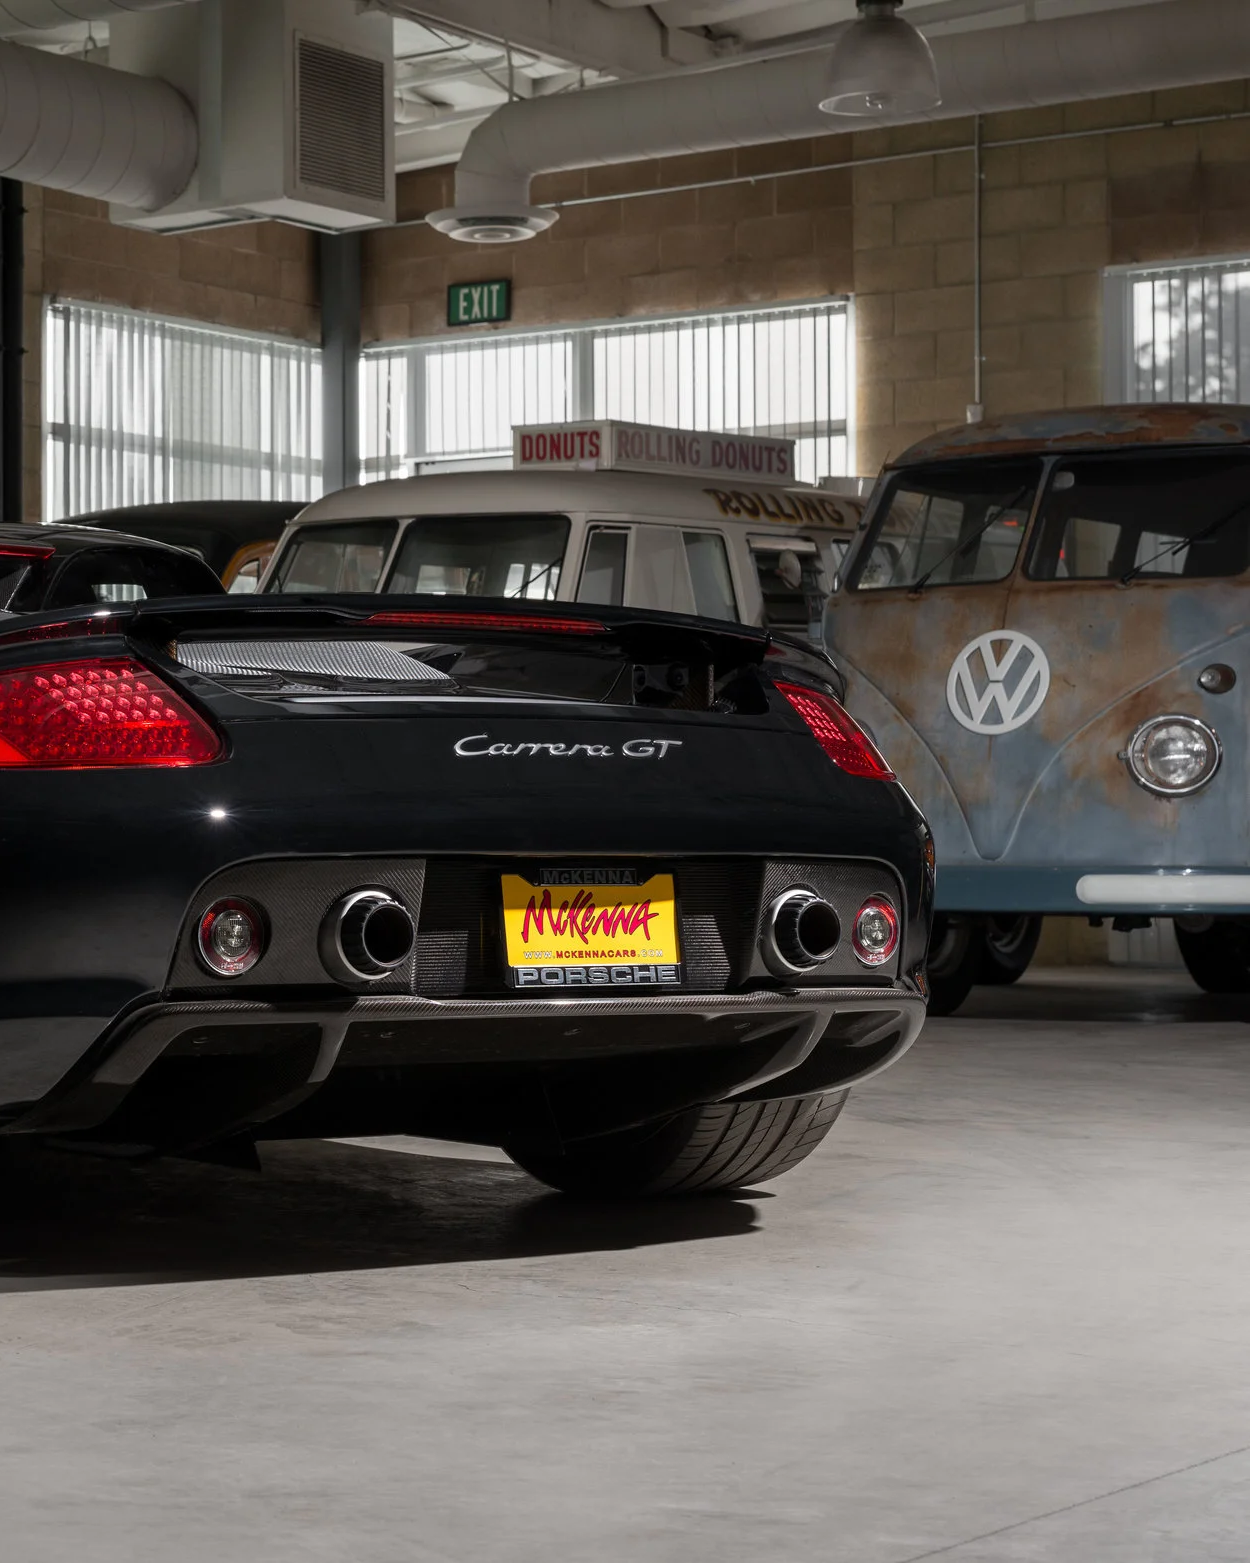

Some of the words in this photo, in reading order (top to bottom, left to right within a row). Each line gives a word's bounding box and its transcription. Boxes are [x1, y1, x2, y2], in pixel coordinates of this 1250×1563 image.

[458, 284, 500, 320] EXIT
[521, 430, 600, 462] DONUTS
[618, 429, 700, 466] ROLLING
[711, 440, 788, 475] DONUTS
[702, 488, 845, 526] ROLLING
[453, 732, 614, 757] Carrera
[622, 739, 683, 760] GT
[542, 869, 635, 884] McKENNA
[517, 965, 678, 985] PORSCHE
